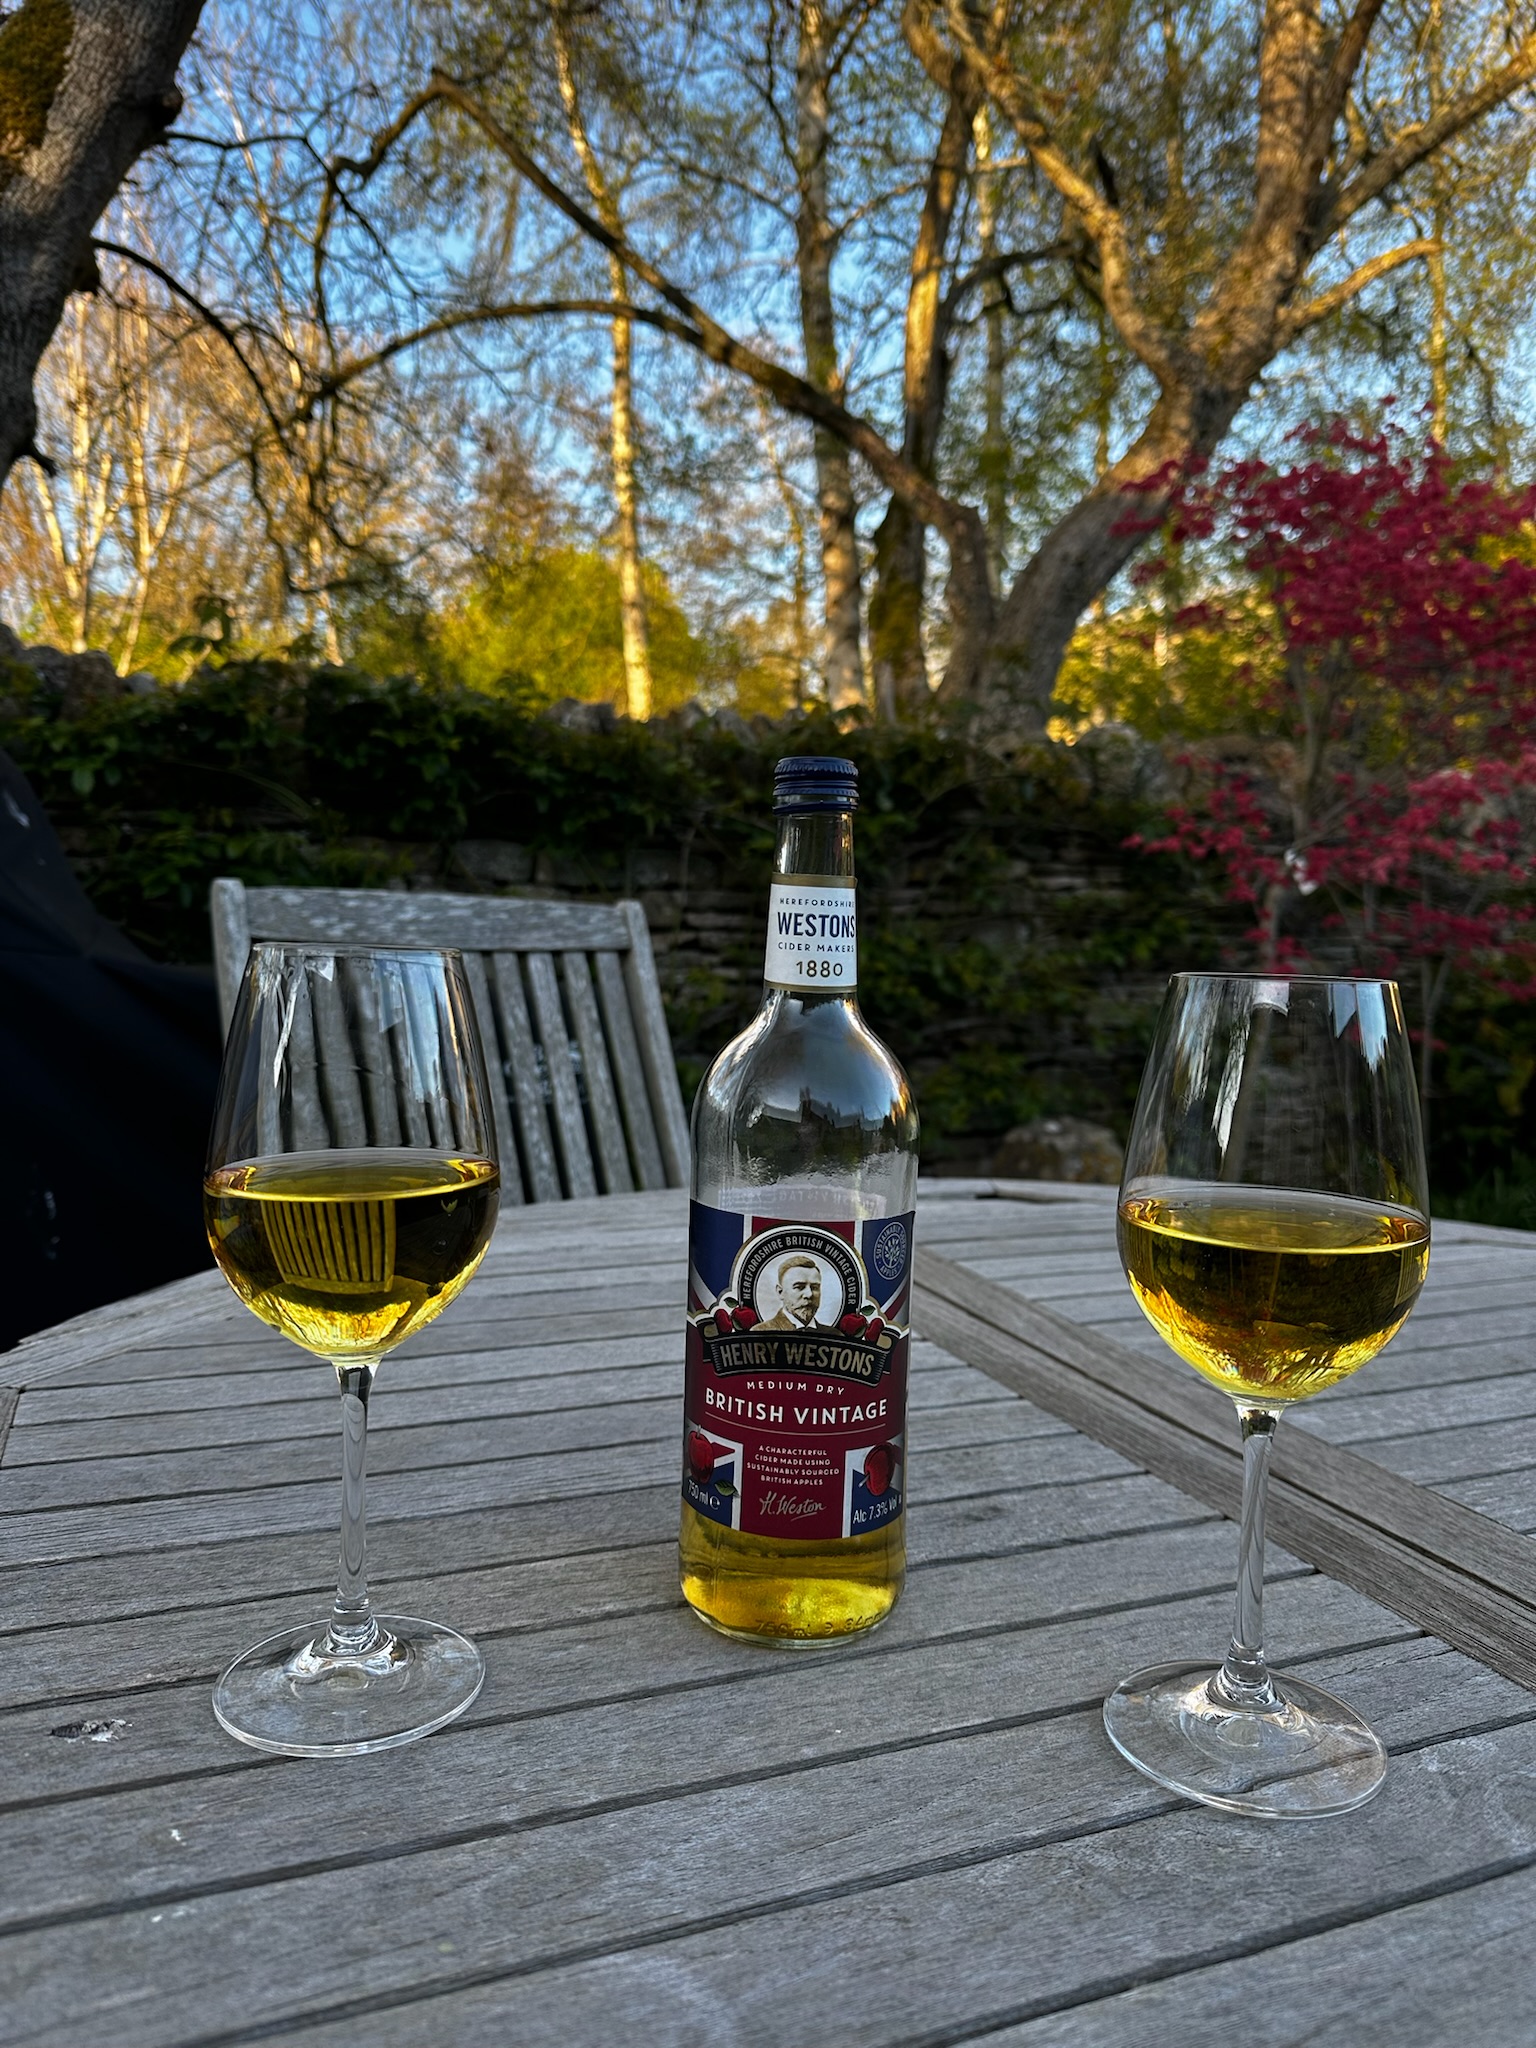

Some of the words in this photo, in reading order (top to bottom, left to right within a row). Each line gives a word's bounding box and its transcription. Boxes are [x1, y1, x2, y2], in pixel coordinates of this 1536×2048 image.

[777, 911, 855, 938] WESTONS
[777, 941, 811, 952] CIDER
[816, 944, 855, 953] MAKERS
[796, 959, 843, 978] 1880
[742, 1238, 784, 1300] HEREFORDSHIRE
[785, 1235, 824, 1249] BRITISH
[825, 1243, 853, 1276] VINTAGE
[846, 1276, 857, 1305] CIDER
[719, 1341, 780, 1368] HENRY
[784, 1342, 875, 1377] WESTONS
[746, 1380, 807, 1392] MEDIUM
[816, 1383, 845, 1396] DRY
[705, 1387, 784, 1424] BRITISH
[793, 1398, 888, 1425] VINTAGE
[765, 1445, 828, 1456] CHARACTERFUL
[754, 1453, 778, 1463] CIDER
[780, 1458, 803, 1466] MADE
[804, 1458, 831, 1466] USING
[746, 1461, 800, 1475] SUSTAINABLY
[801, 1467, 840, 1476] SOURCED
[760, 1474, 792, 1485] BRITISH
[793, 1478, 824, 1486] APPLES
[852, 1507, 867, 1524] Alc
[868, 1500, 889, 1521] 7.3%
